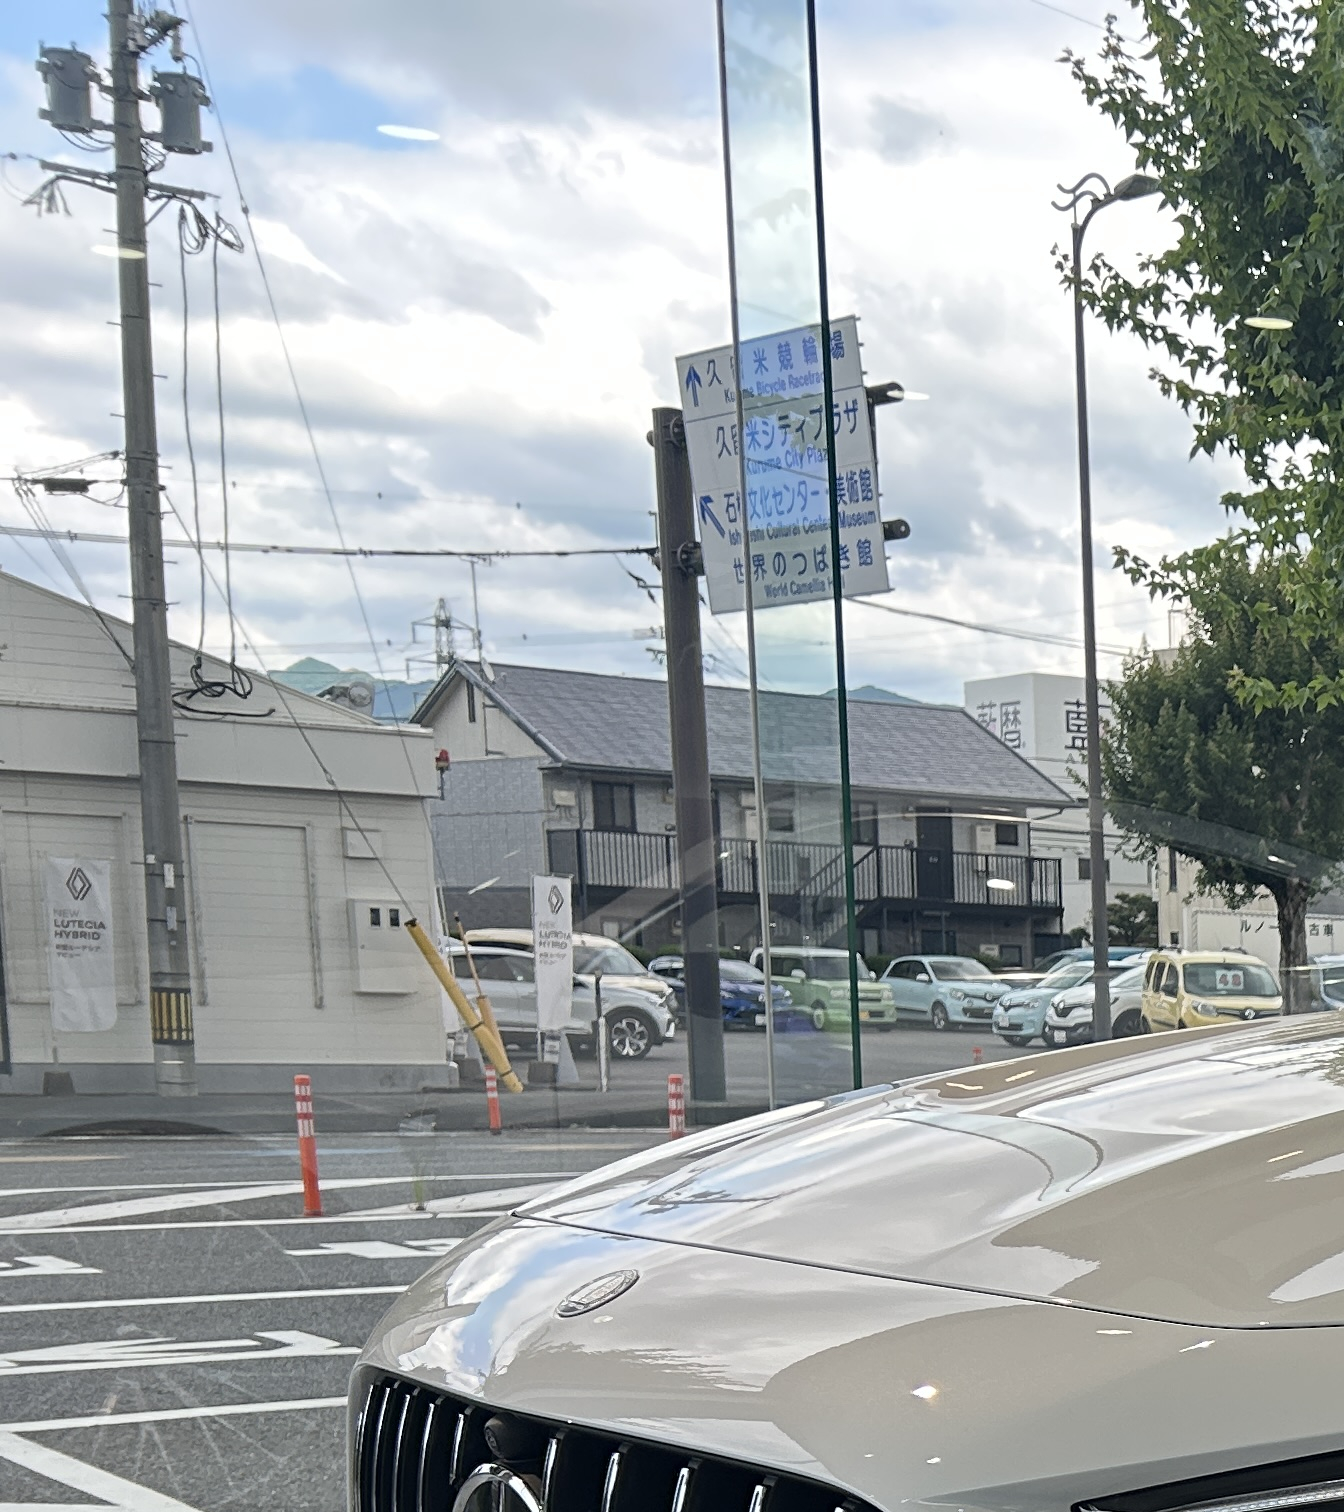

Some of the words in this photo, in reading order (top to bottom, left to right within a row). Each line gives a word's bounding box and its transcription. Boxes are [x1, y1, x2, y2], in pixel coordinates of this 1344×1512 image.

[756, 377, 787, 398] Bicycle
[788, 371, 824, 389] Racetrac
[785, 449, 804, 469] City
[54, 919, 106, 930] LUTECIA
[54, 930, 101, 941] HYBRID
